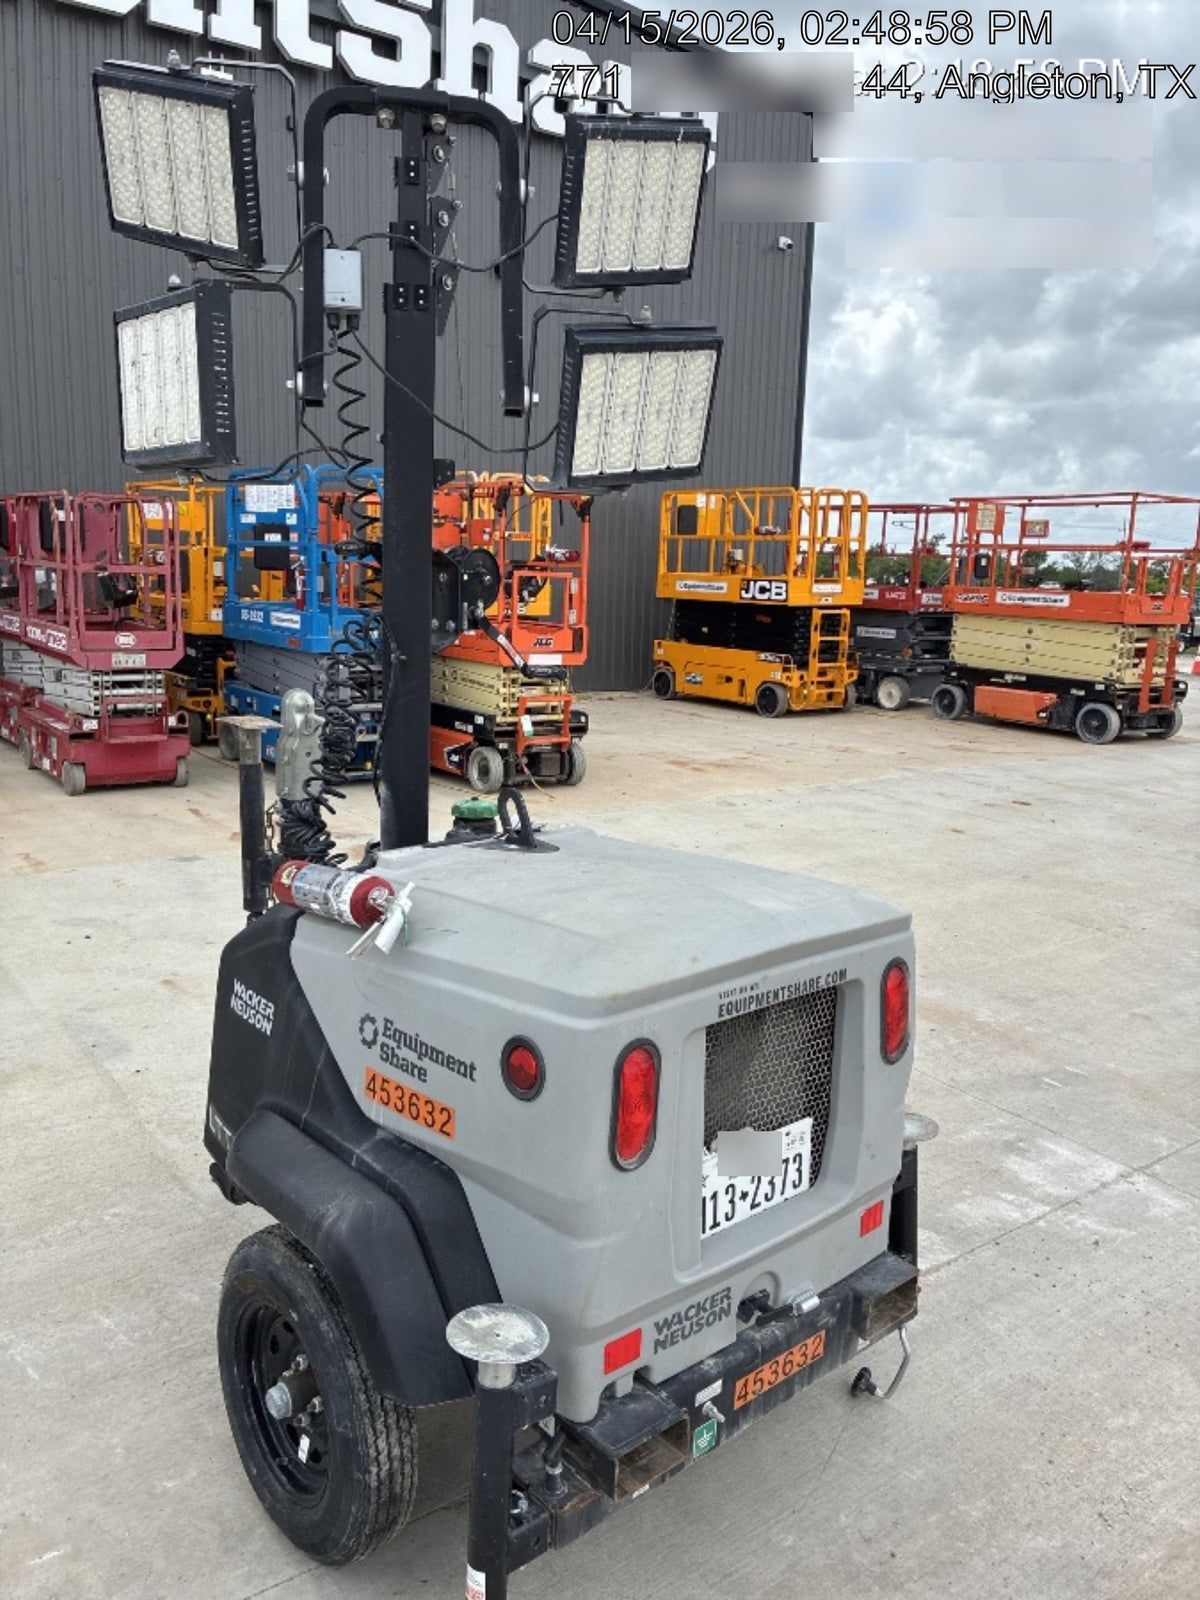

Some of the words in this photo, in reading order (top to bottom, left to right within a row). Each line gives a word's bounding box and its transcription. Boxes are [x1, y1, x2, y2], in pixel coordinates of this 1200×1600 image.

[741, 580, 787, 600] JCB
[230, 994, 272, 1037] NEUSON
[233, 977, 274, 1020] WACKER
[717, 968, 847, 1018] EQUIPMENTSHARE.COM
[380, 1041, 427, 1083] Share
[382, 1017, 477, 1082] Equipment
[365, 1073, 452, 1137] 453632
[653, 1286, 732, 1336] WACKER
[653, 1301, 732, 1355] NEUSON
[736, 1333, 823, 1401] 453632
